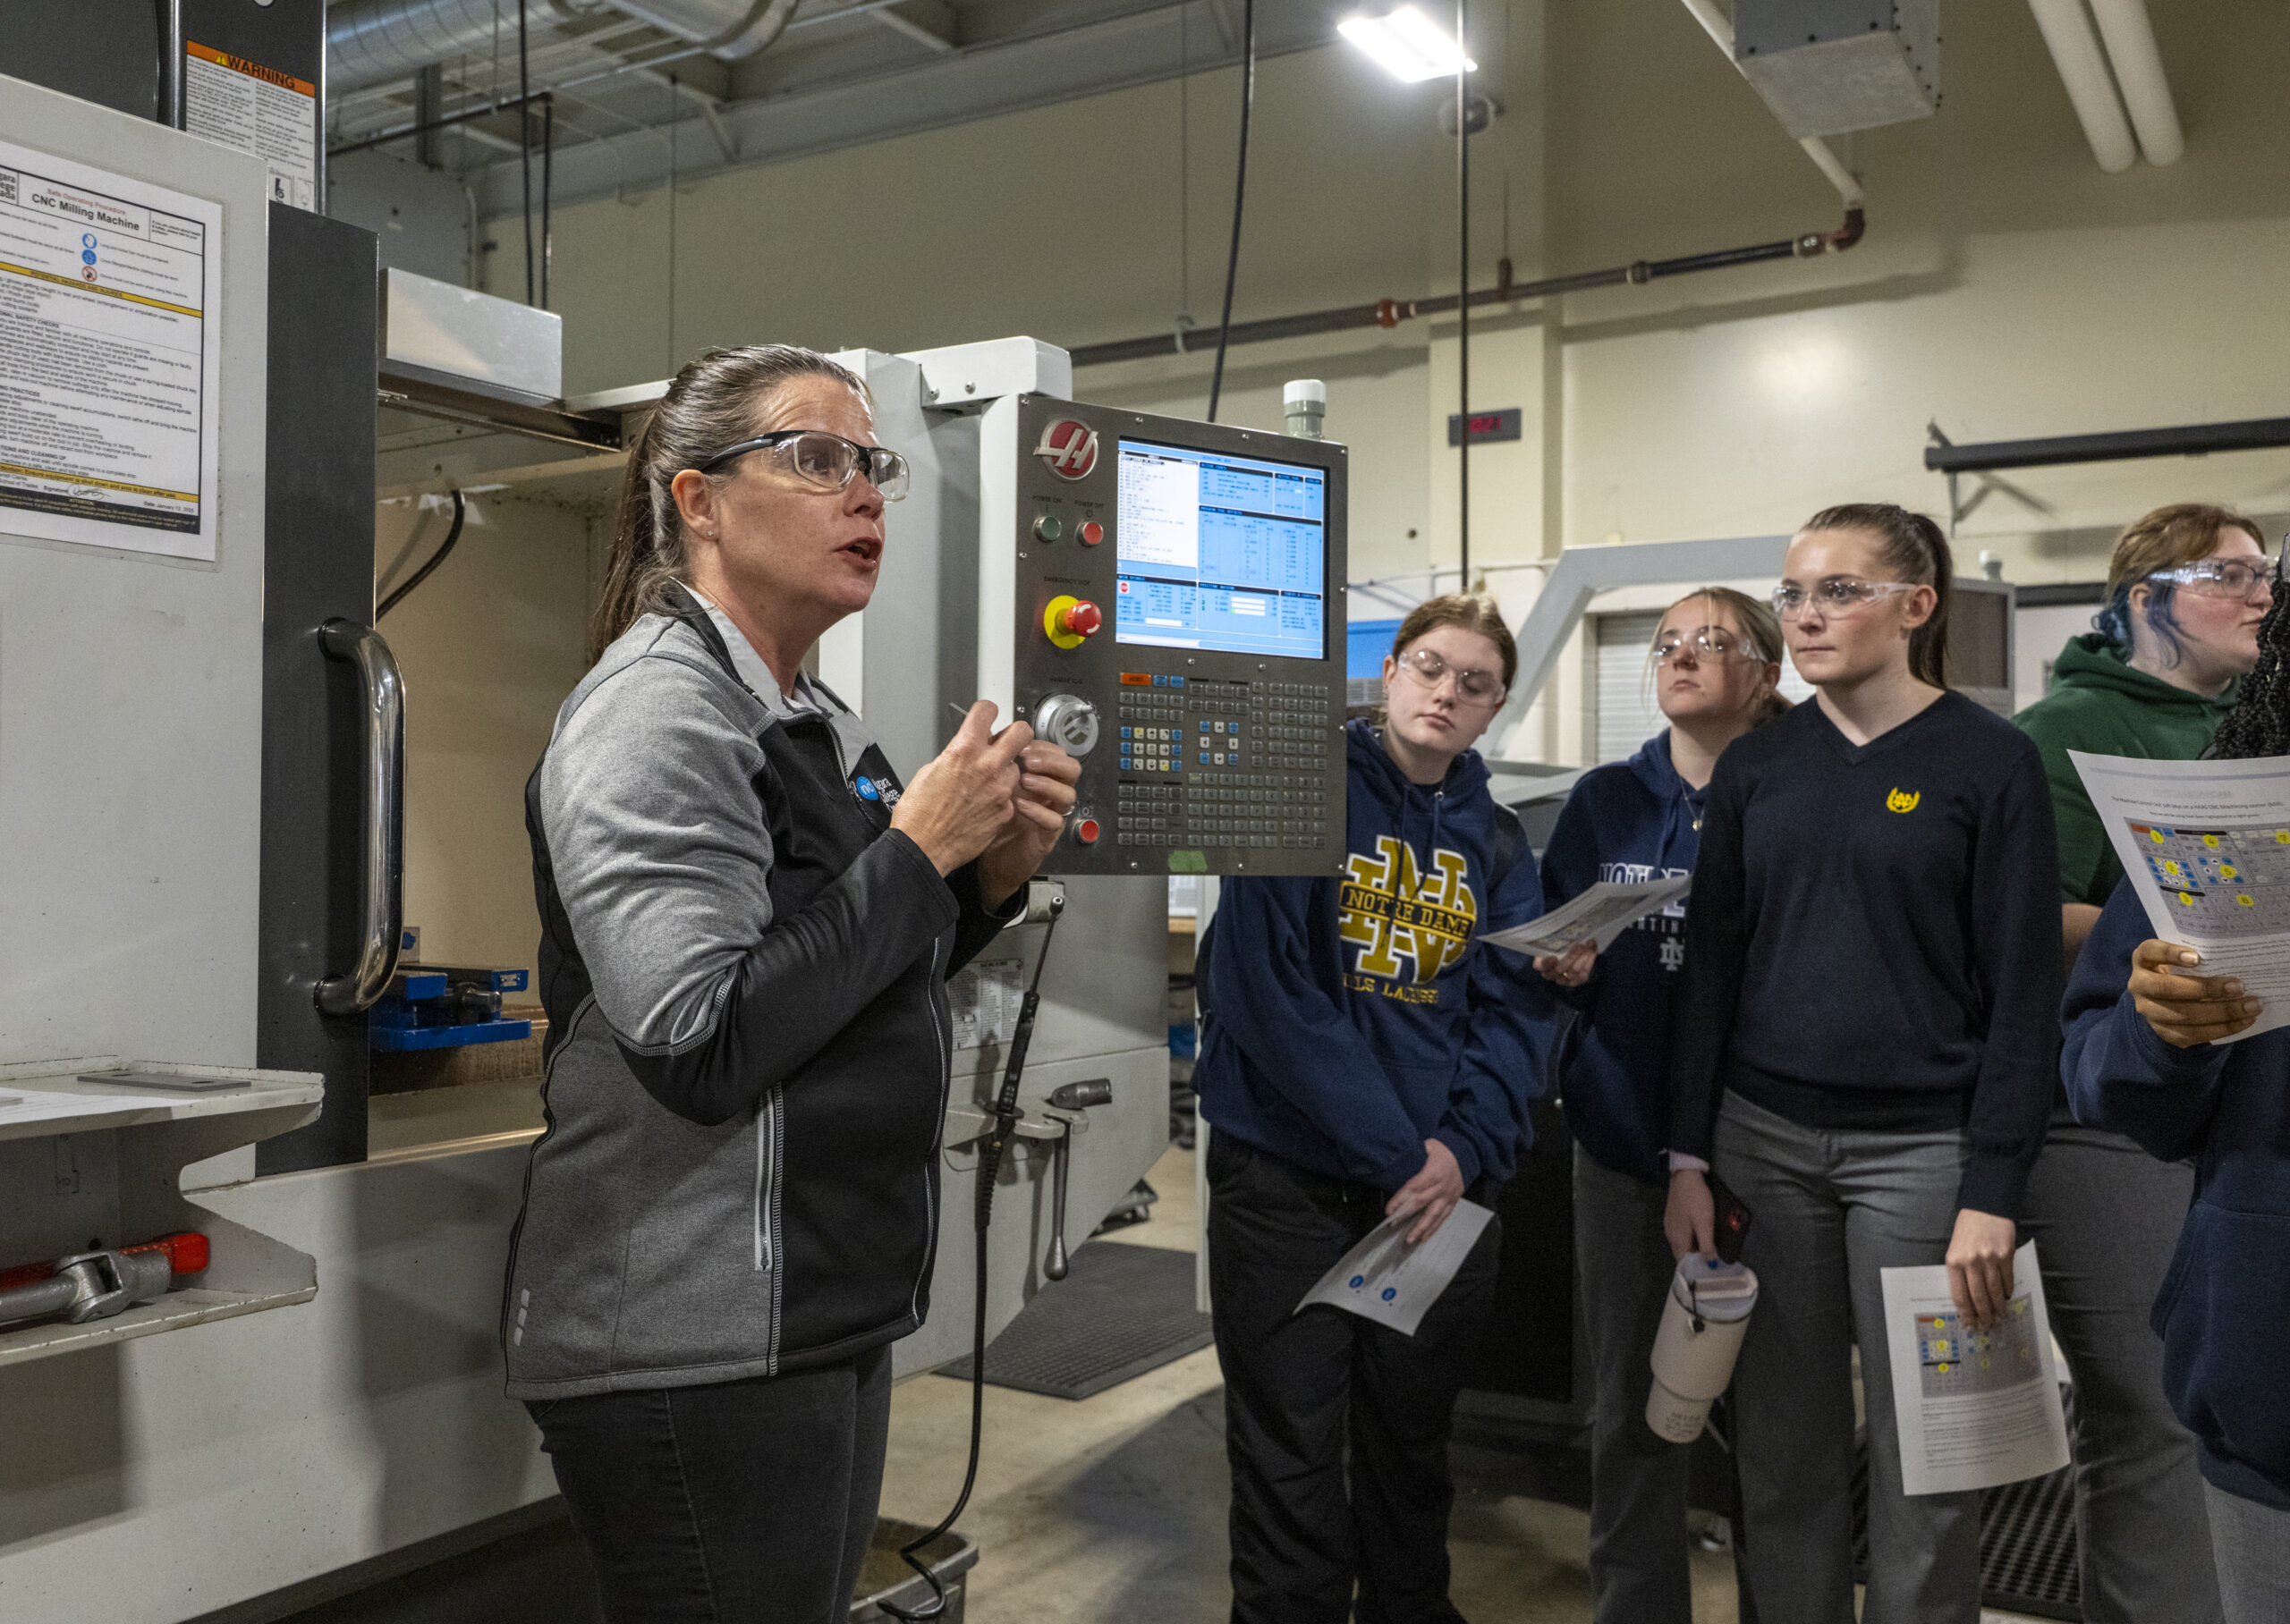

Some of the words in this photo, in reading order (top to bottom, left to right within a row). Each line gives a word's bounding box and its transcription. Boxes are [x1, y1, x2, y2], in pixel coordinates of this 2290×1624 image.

[228, 55, 295, 89] WARNING
[32, 192, 56, 209] CNC
[59, 199, 94, 220] Milling
[97, 210, 139, 231] Machine
[1347, 888, 1414, 922] NOTRE
[1419, 907, 1469, 936] DAME
